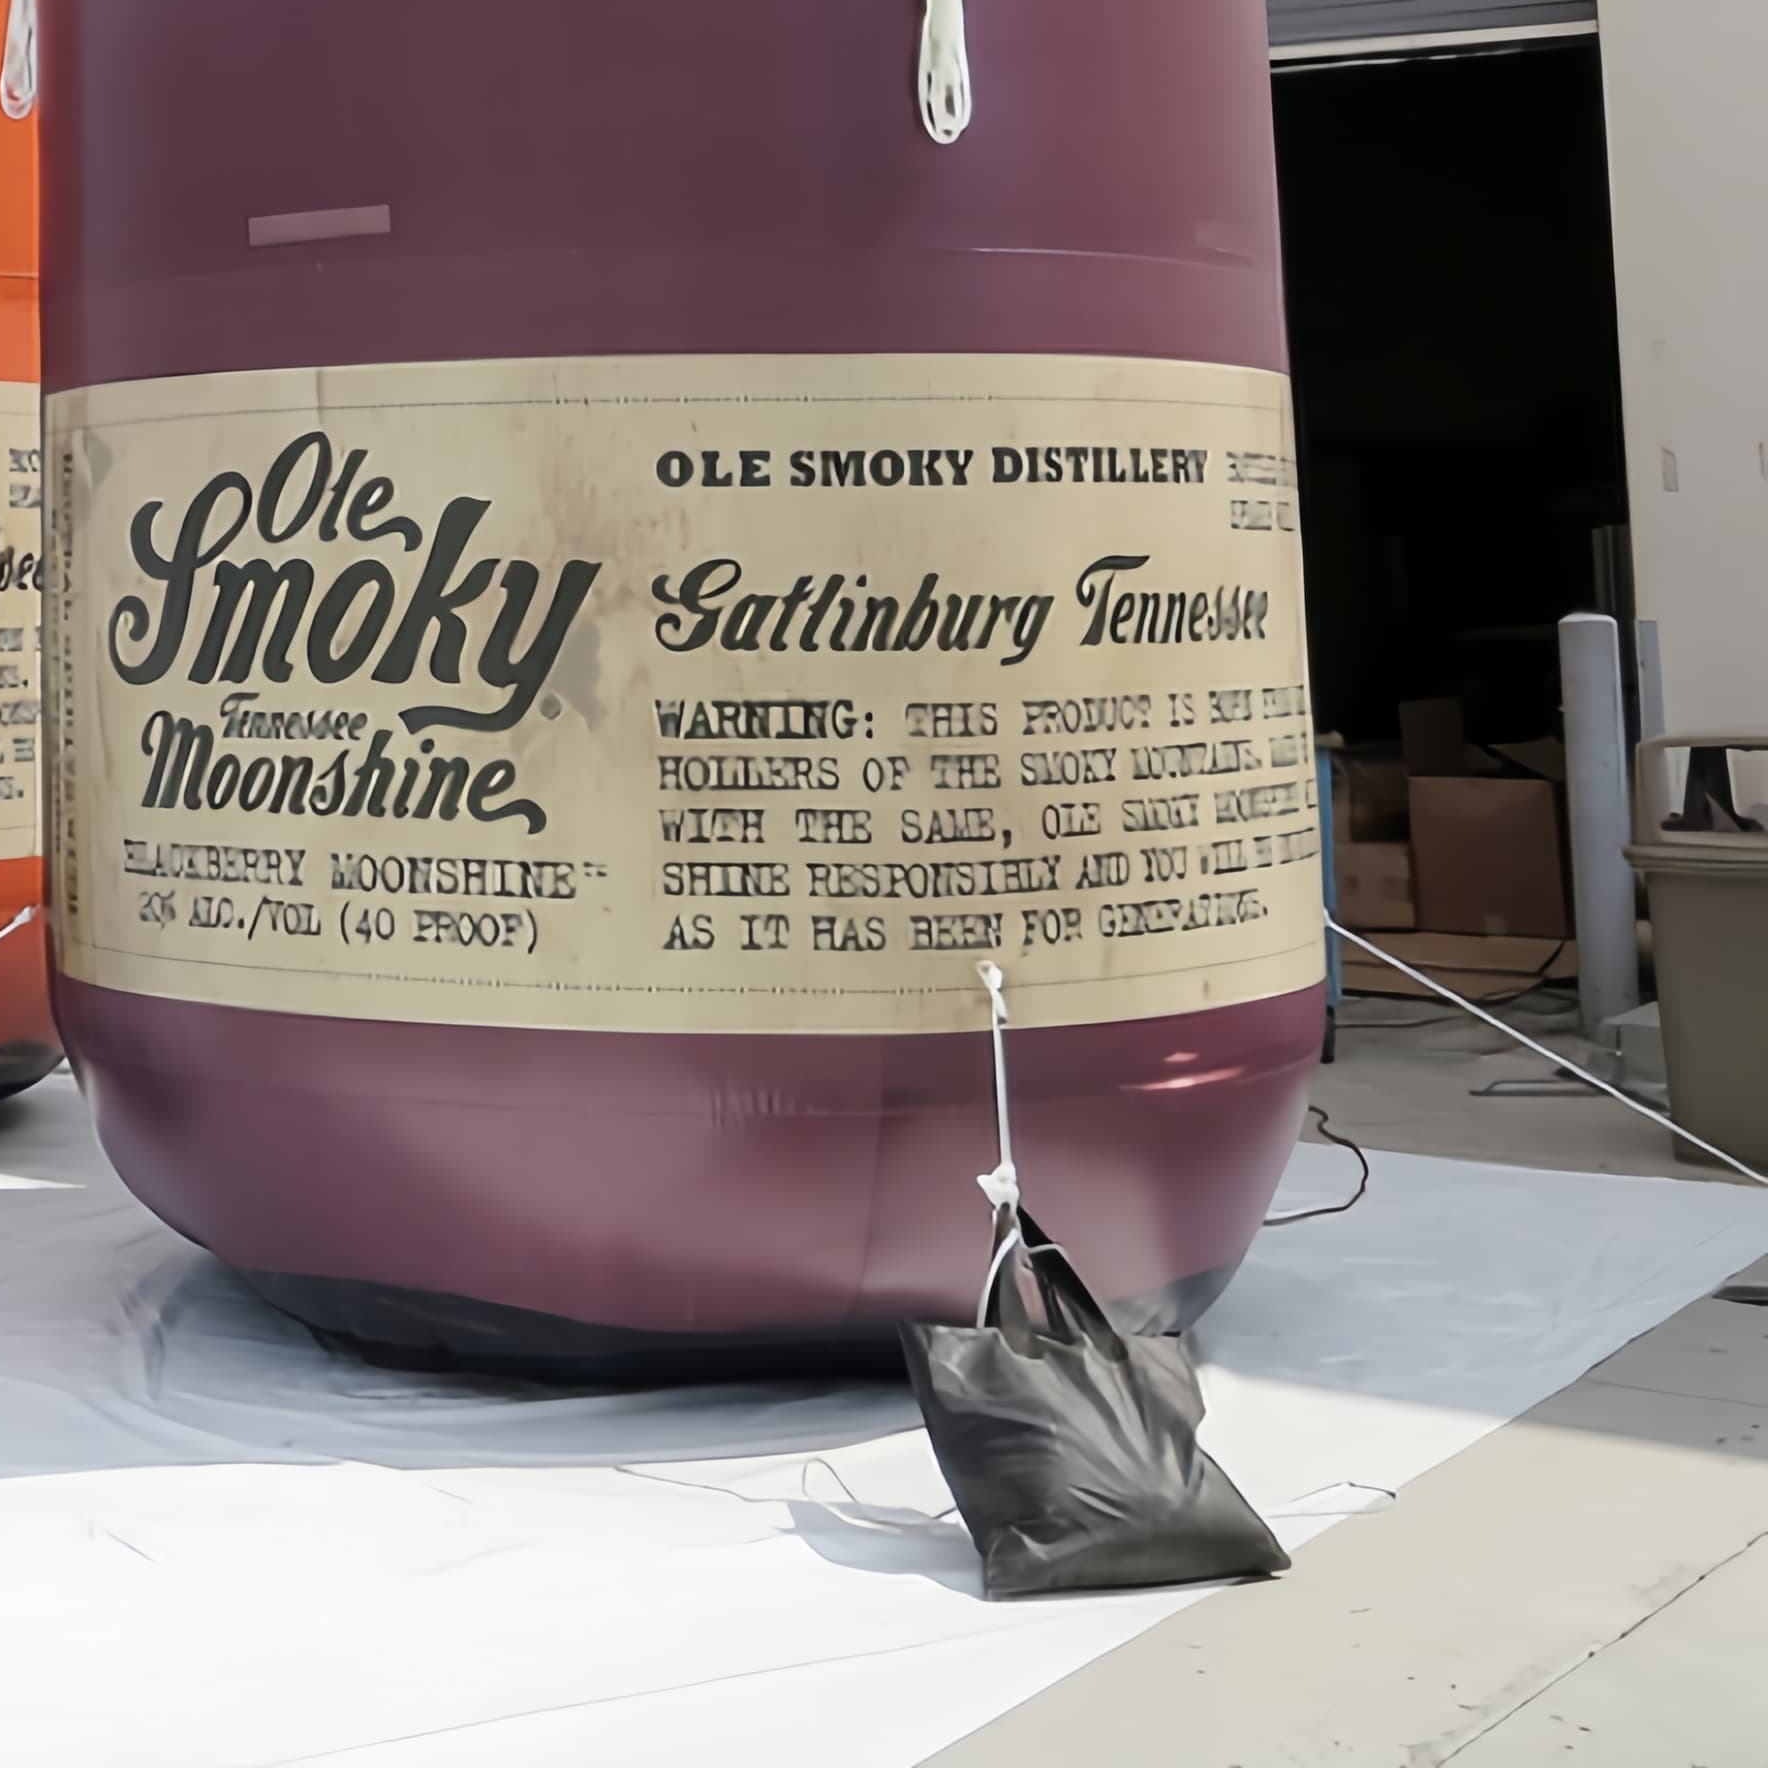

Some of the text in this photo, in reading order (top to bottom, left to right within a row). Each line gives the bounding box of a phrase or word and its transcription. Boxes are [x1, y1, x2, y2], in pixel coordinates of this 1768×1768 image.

[656, 449, 771, 487] OLE
[789, 449, 974, 487] SMOKY
[991, 446, 1208, 483] DISTILLERY
[257, 431, 423, 552] Ole
[108, 470, 603, 734] Smoky
[651, 554, 1269, 666] Gatlinburg Tennessee
[655, 698, 874, 740] WARNING:
[905, 702, 998, 737] THIS
[1022, 694, 1151, 736] PRODUCT
[1168, 692, 1195, 727] IS
[140, 710, 547, 835] Moonshine
[658, 755, 840, 791] HOLLERS
[862, 755, 910, 792] OF
[930, 752, 1001, 789] THE
[1021, 747, 1117, 786] SMOKY
[658, 808, 765, 844] WITH
[795, 808, 872, 844] THE
[901, 807, 1012, 850] SAME,
[1042, 802, 1102, 840] OLE
[662, 862, 790, 897] SHINE
[806, 854, 1061, 899] RESPONSIBLY
[1075, 850, 1131, 891] AND
[339, 901, 395, 945] (40
[412, 907, 537, 955] PROOF)
[662, 914, 715, 950] AS
[740, 914, 790, 950] IT
[811, 914, 887, 951] HAS
[909, 912, 1003, 951] BEEN
[1021, 907, 1083, 947] FOR
